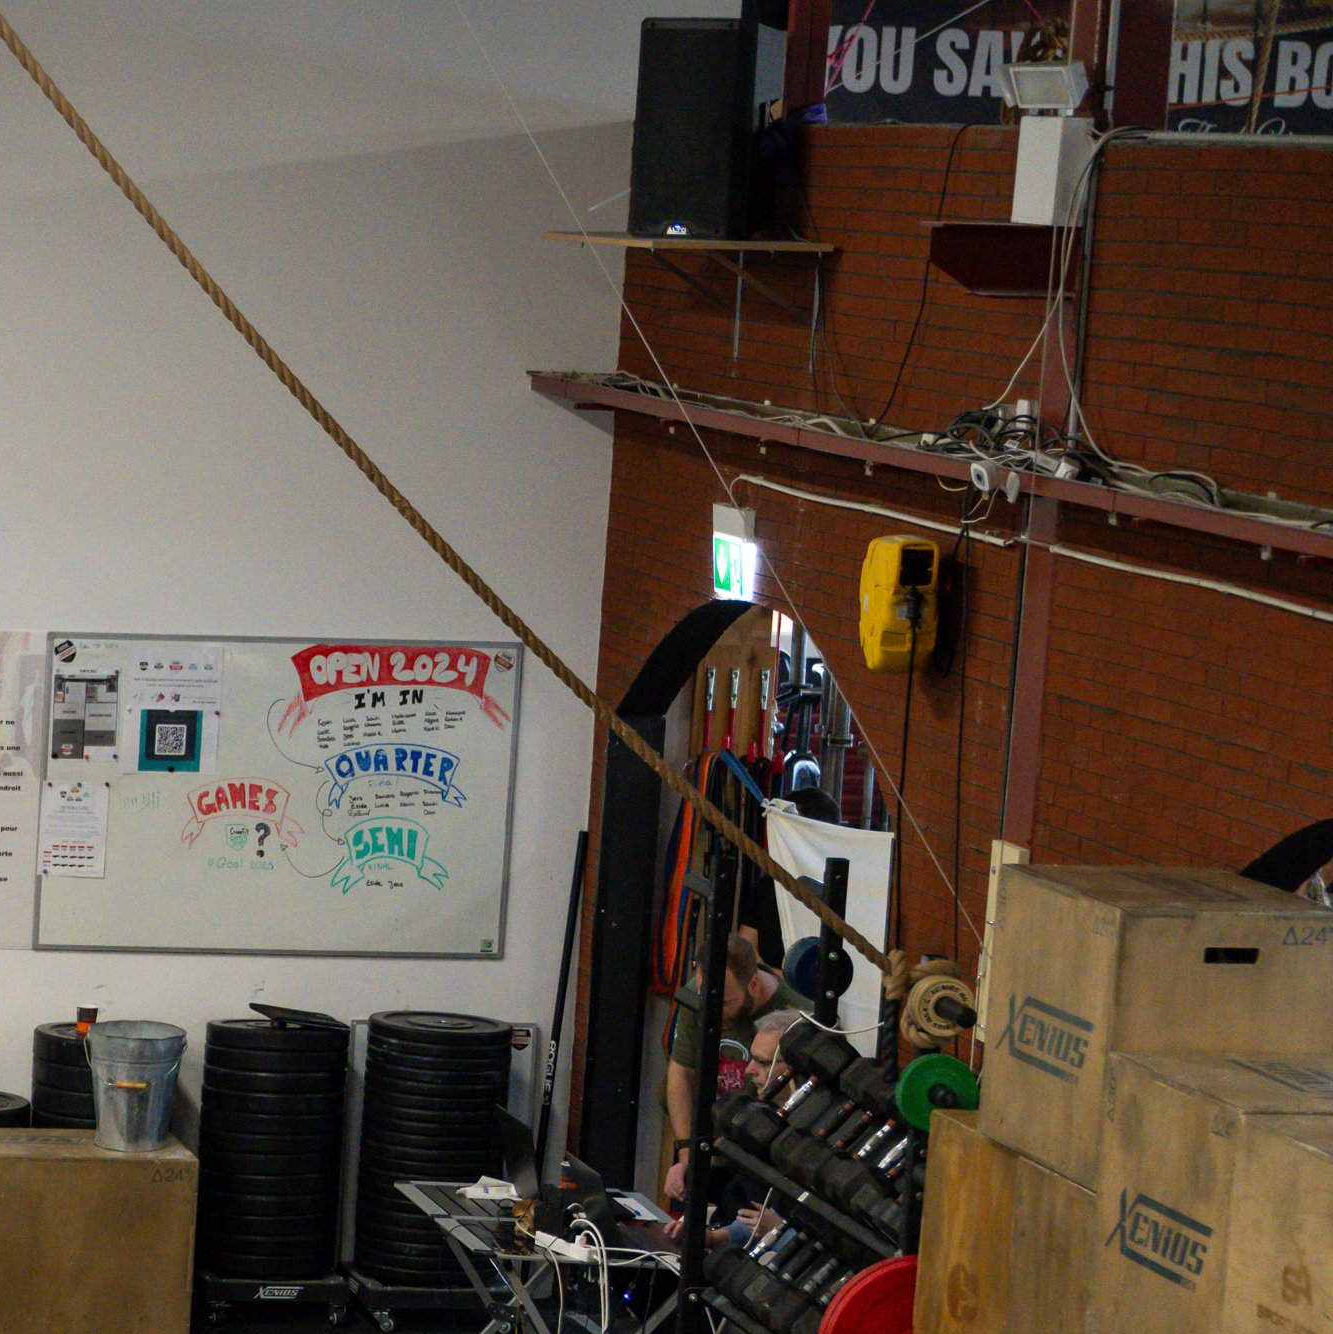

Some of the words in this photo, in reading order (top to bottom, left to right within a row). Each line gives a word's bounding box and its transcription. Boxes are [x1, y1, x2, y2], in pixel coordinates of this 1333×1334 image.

[934, 28, 1025, 97] SA
[309, 651, 380, 685] OPEN
[389, 651, 478, 686] 2024
[354, 689, 386, 710] I'M
[399, 689, 424, 706] IN
[335, 748, 454, 786] QUARTER
[197, 783, 279, 816] GAMES
[254, 822, 271, 858] ?
[353, 827, 419, 861] SEMI
[995, 992, 1094, 1080] XENIOS
[1105, 1188, 1213, 1284] XENIOS
[254, 1286, 304, 1299] XENIOS
